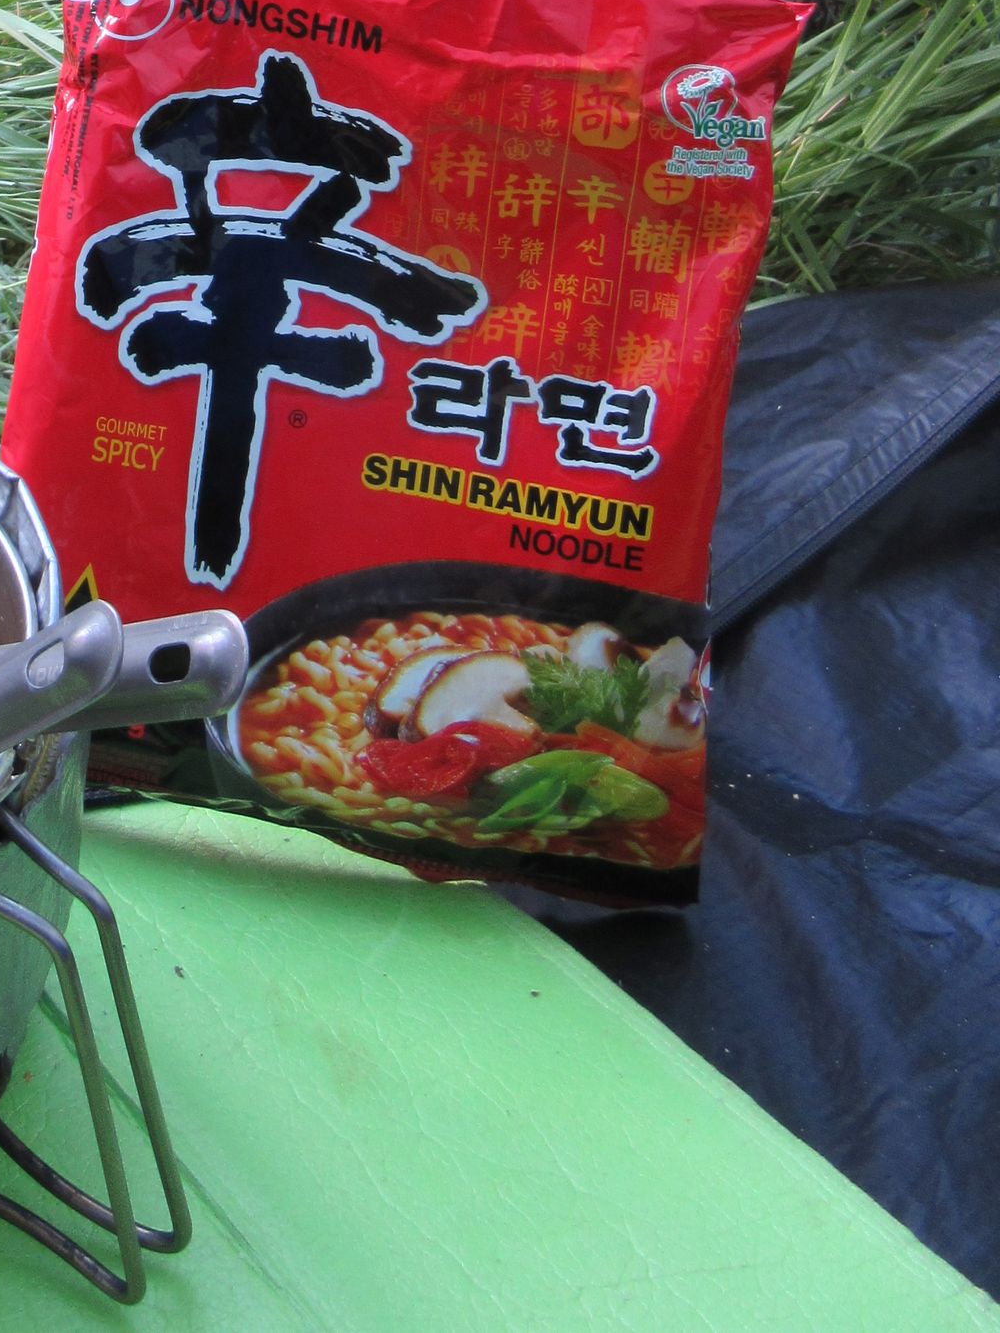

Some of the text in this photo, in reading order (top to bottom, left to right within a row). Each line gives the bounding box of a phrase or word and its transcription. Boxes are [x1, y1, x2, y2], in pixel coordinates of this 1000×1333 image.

[680, 101, 766, 148] Vegan
[666, 159, 755, 180] the Vegan Society
[673, 146, 748, 162] Registered with
[74, 49, 489, 590] 辛
[96, 416, 168, 441] GOURMET
[407, 356, 660, 480] 라면
[91, 436, 165, 472] SPICY
[362, 453, 655, 542] SHIN RAMYUN
[508, 524, 645, 572] NOODLE
